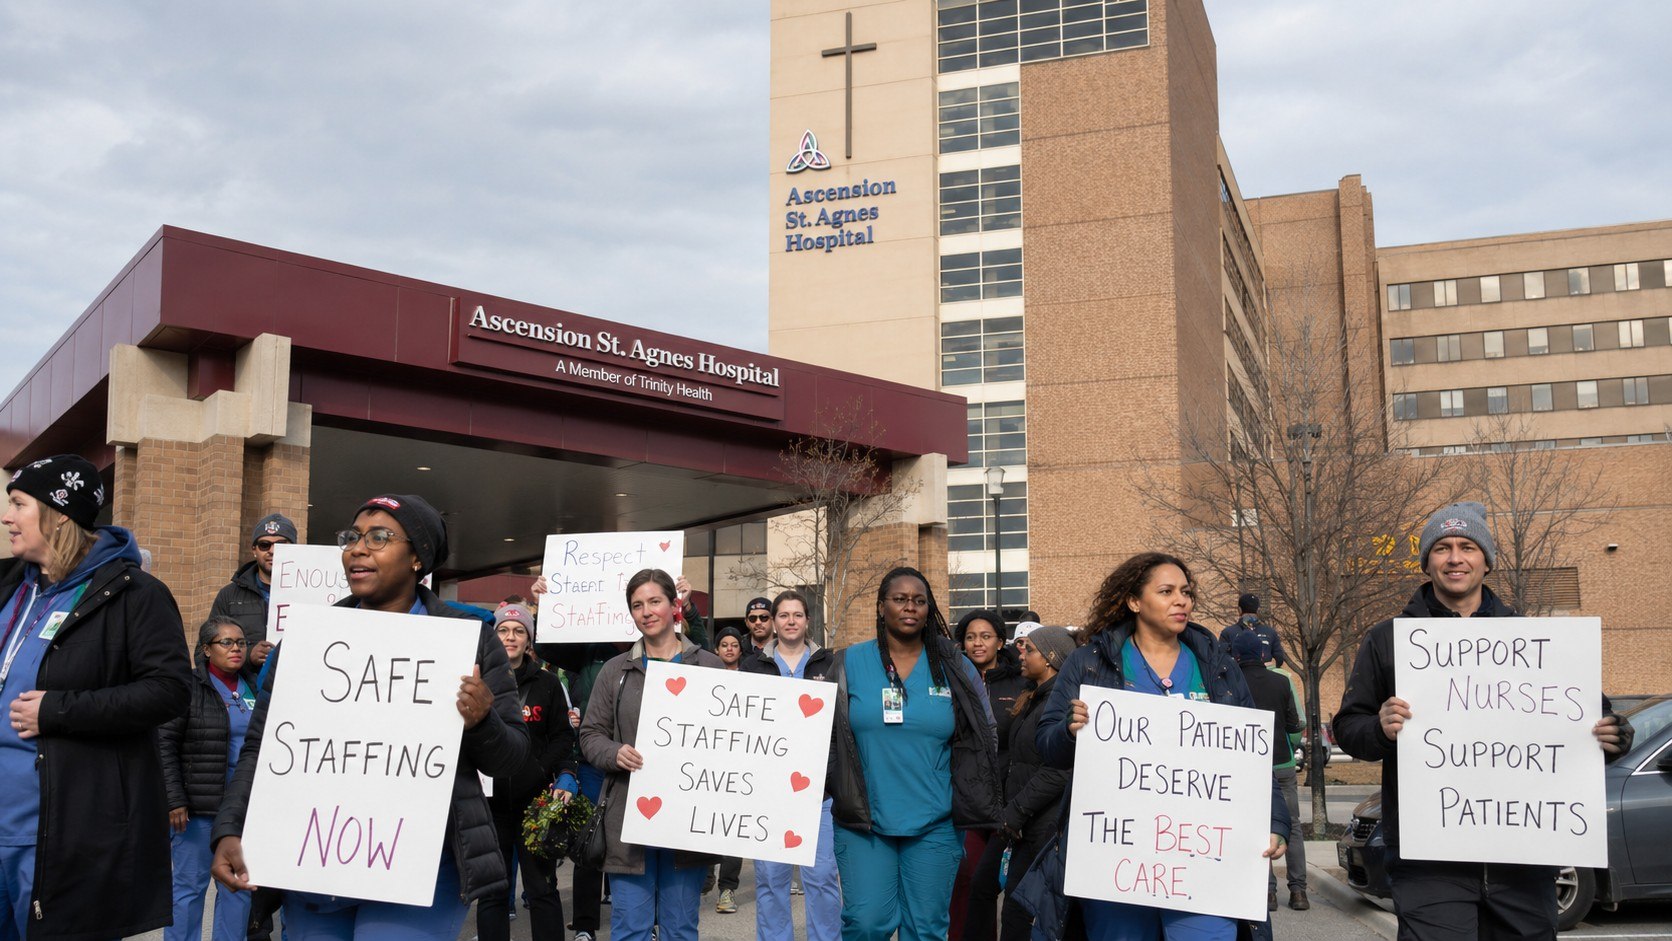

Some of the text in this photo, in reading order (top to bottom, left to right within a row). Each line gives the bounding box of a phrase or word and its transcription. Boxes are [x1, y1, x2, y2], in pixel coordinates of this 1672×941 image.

[785, 178, 897, 206] Ascension
[785, 206, 879, 229] St. Agnes
[785, 225, 874, 253] Hospital
[469, 305, 780, 388] Ascension St. Agnes Hospital
[555, 359, 712, 401] A Member of Trinity Health
[1409, 628, 1551, 670] SUPPORT
[320, 640, 436, 705] SAFE
[708, 684, 777, 722] SAFE
[1446, 675, 1584, 722] NURSES
[268, 721, 446, 779] STAFFING
[653, 716, 789, 758] STAFFING
[1094, 700, 1269, 756] OUR PATIENTS
[1423, 727, 1565, 774] SUPPORT
[678, 761, 754, 796] SAVES
[1118, 756, 1232, 802] DESERVE
[689, 805, 770, 842] LIVES
[1082, 811, 1233, 857] THE BEST
[1439, 786, 1588, 836] PATIENTS
[297, 804, 404, 871] NOW
